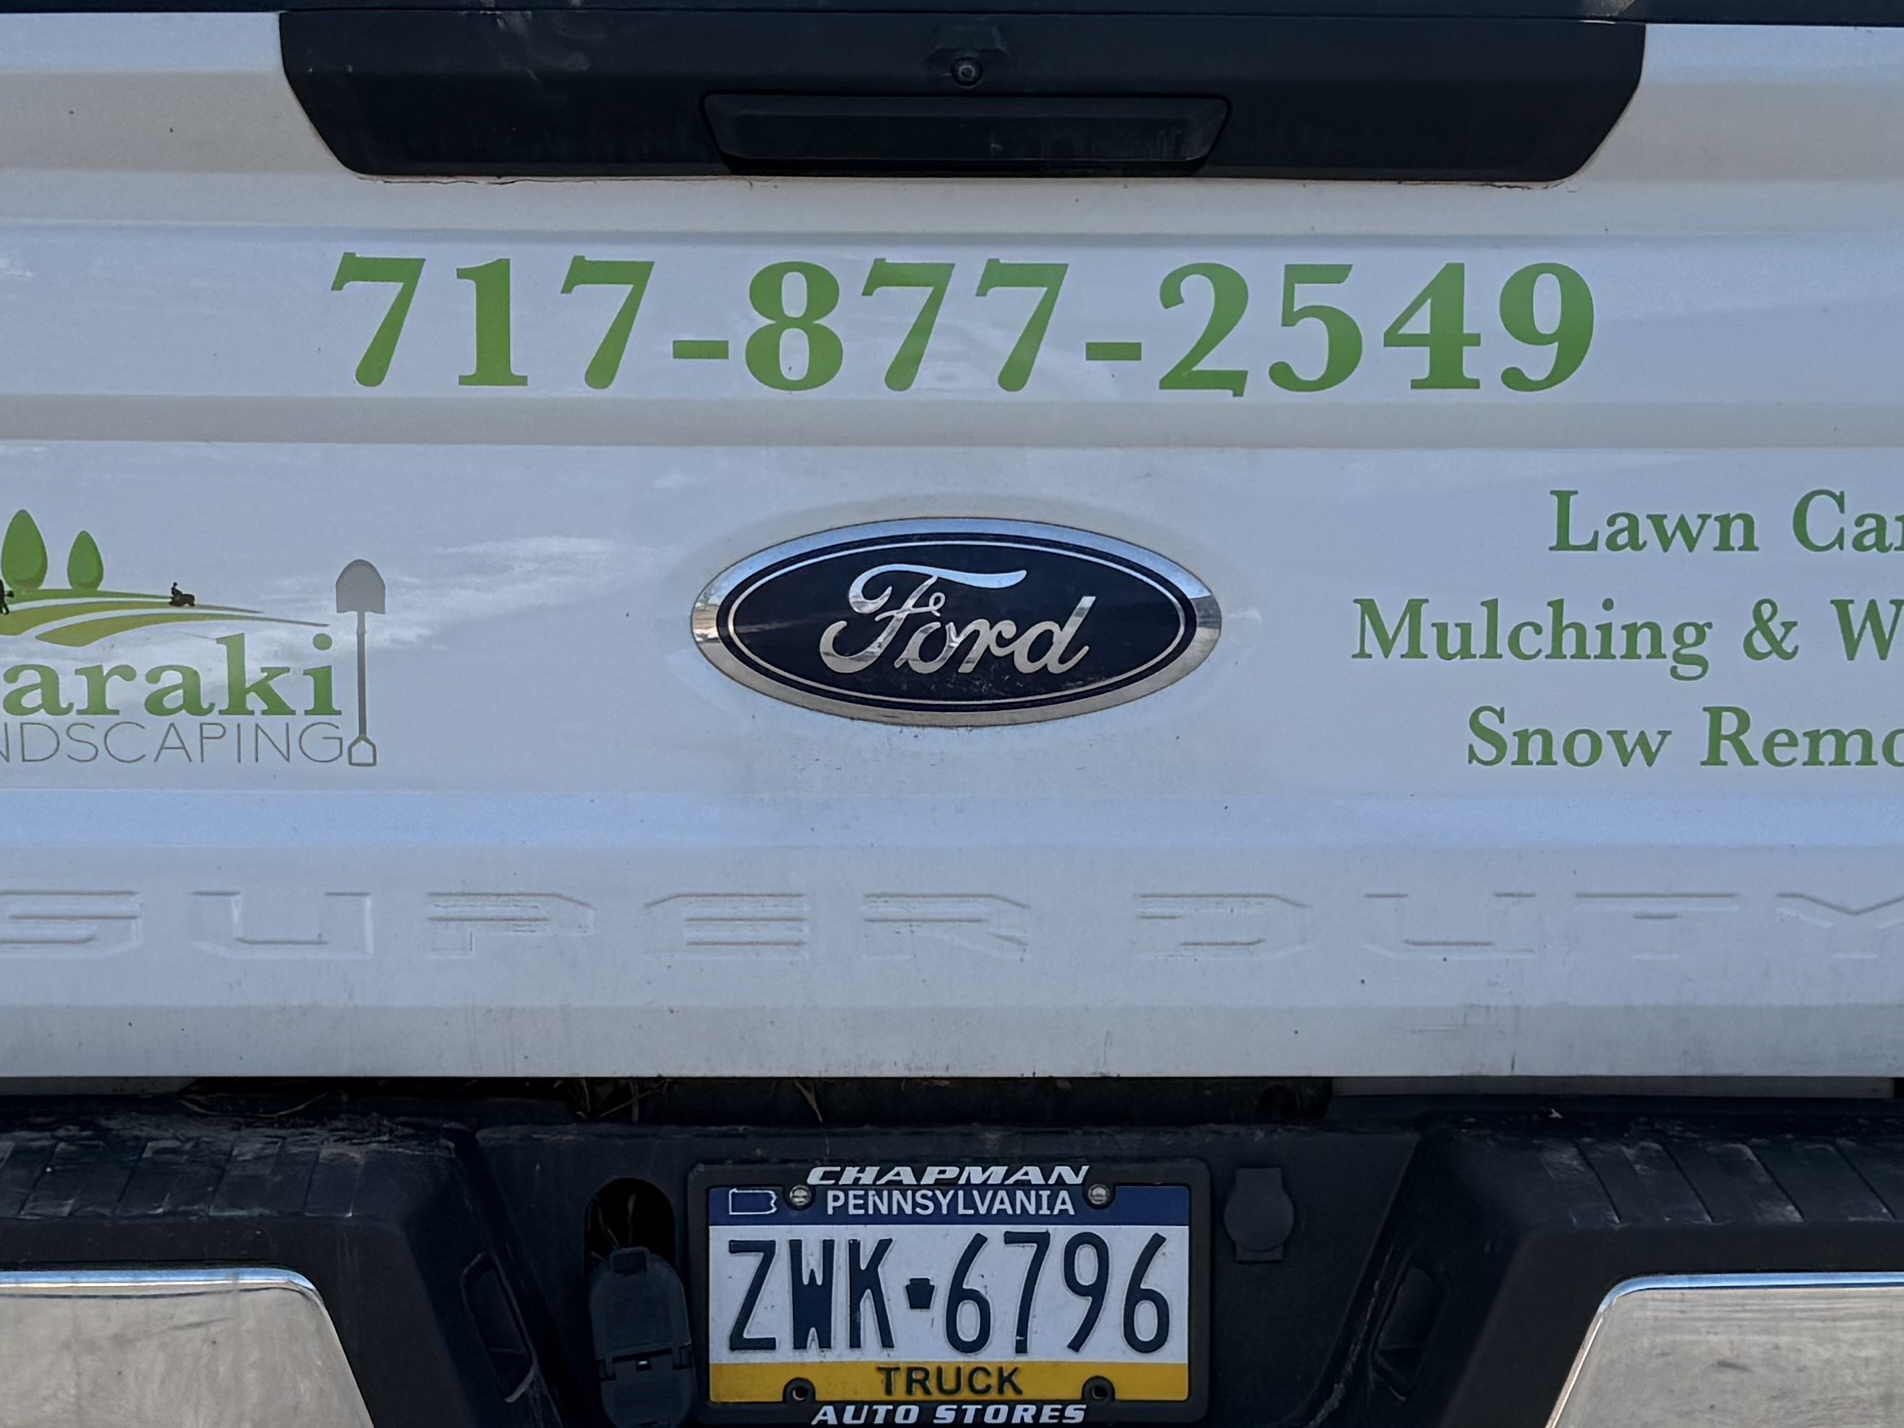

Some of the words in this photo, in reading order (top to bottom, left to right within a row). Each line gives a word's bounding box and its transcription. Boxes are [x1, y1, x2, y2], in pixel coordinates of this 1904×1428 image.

[330, 251, 1595, 398] 717-877-2549
[1548, 489, 1760, 554] Lawn
[819, 562, 1096, 675] Ford
[1351, 597, 1713, 682] Mulching
[1742, 597, 1800, 662] &
[1467, 705, 1673, 768] Snow
[806, 1165, 1089, 1186] CHAPMAN
[826, 1188, 1076, 1216] PENNSYLVANIA
[876, 1365, 1023, 1397] TRUCK
[811, 1404, 923, 1426] AUTO
[932, 1403, 1087, 1425] STORES
